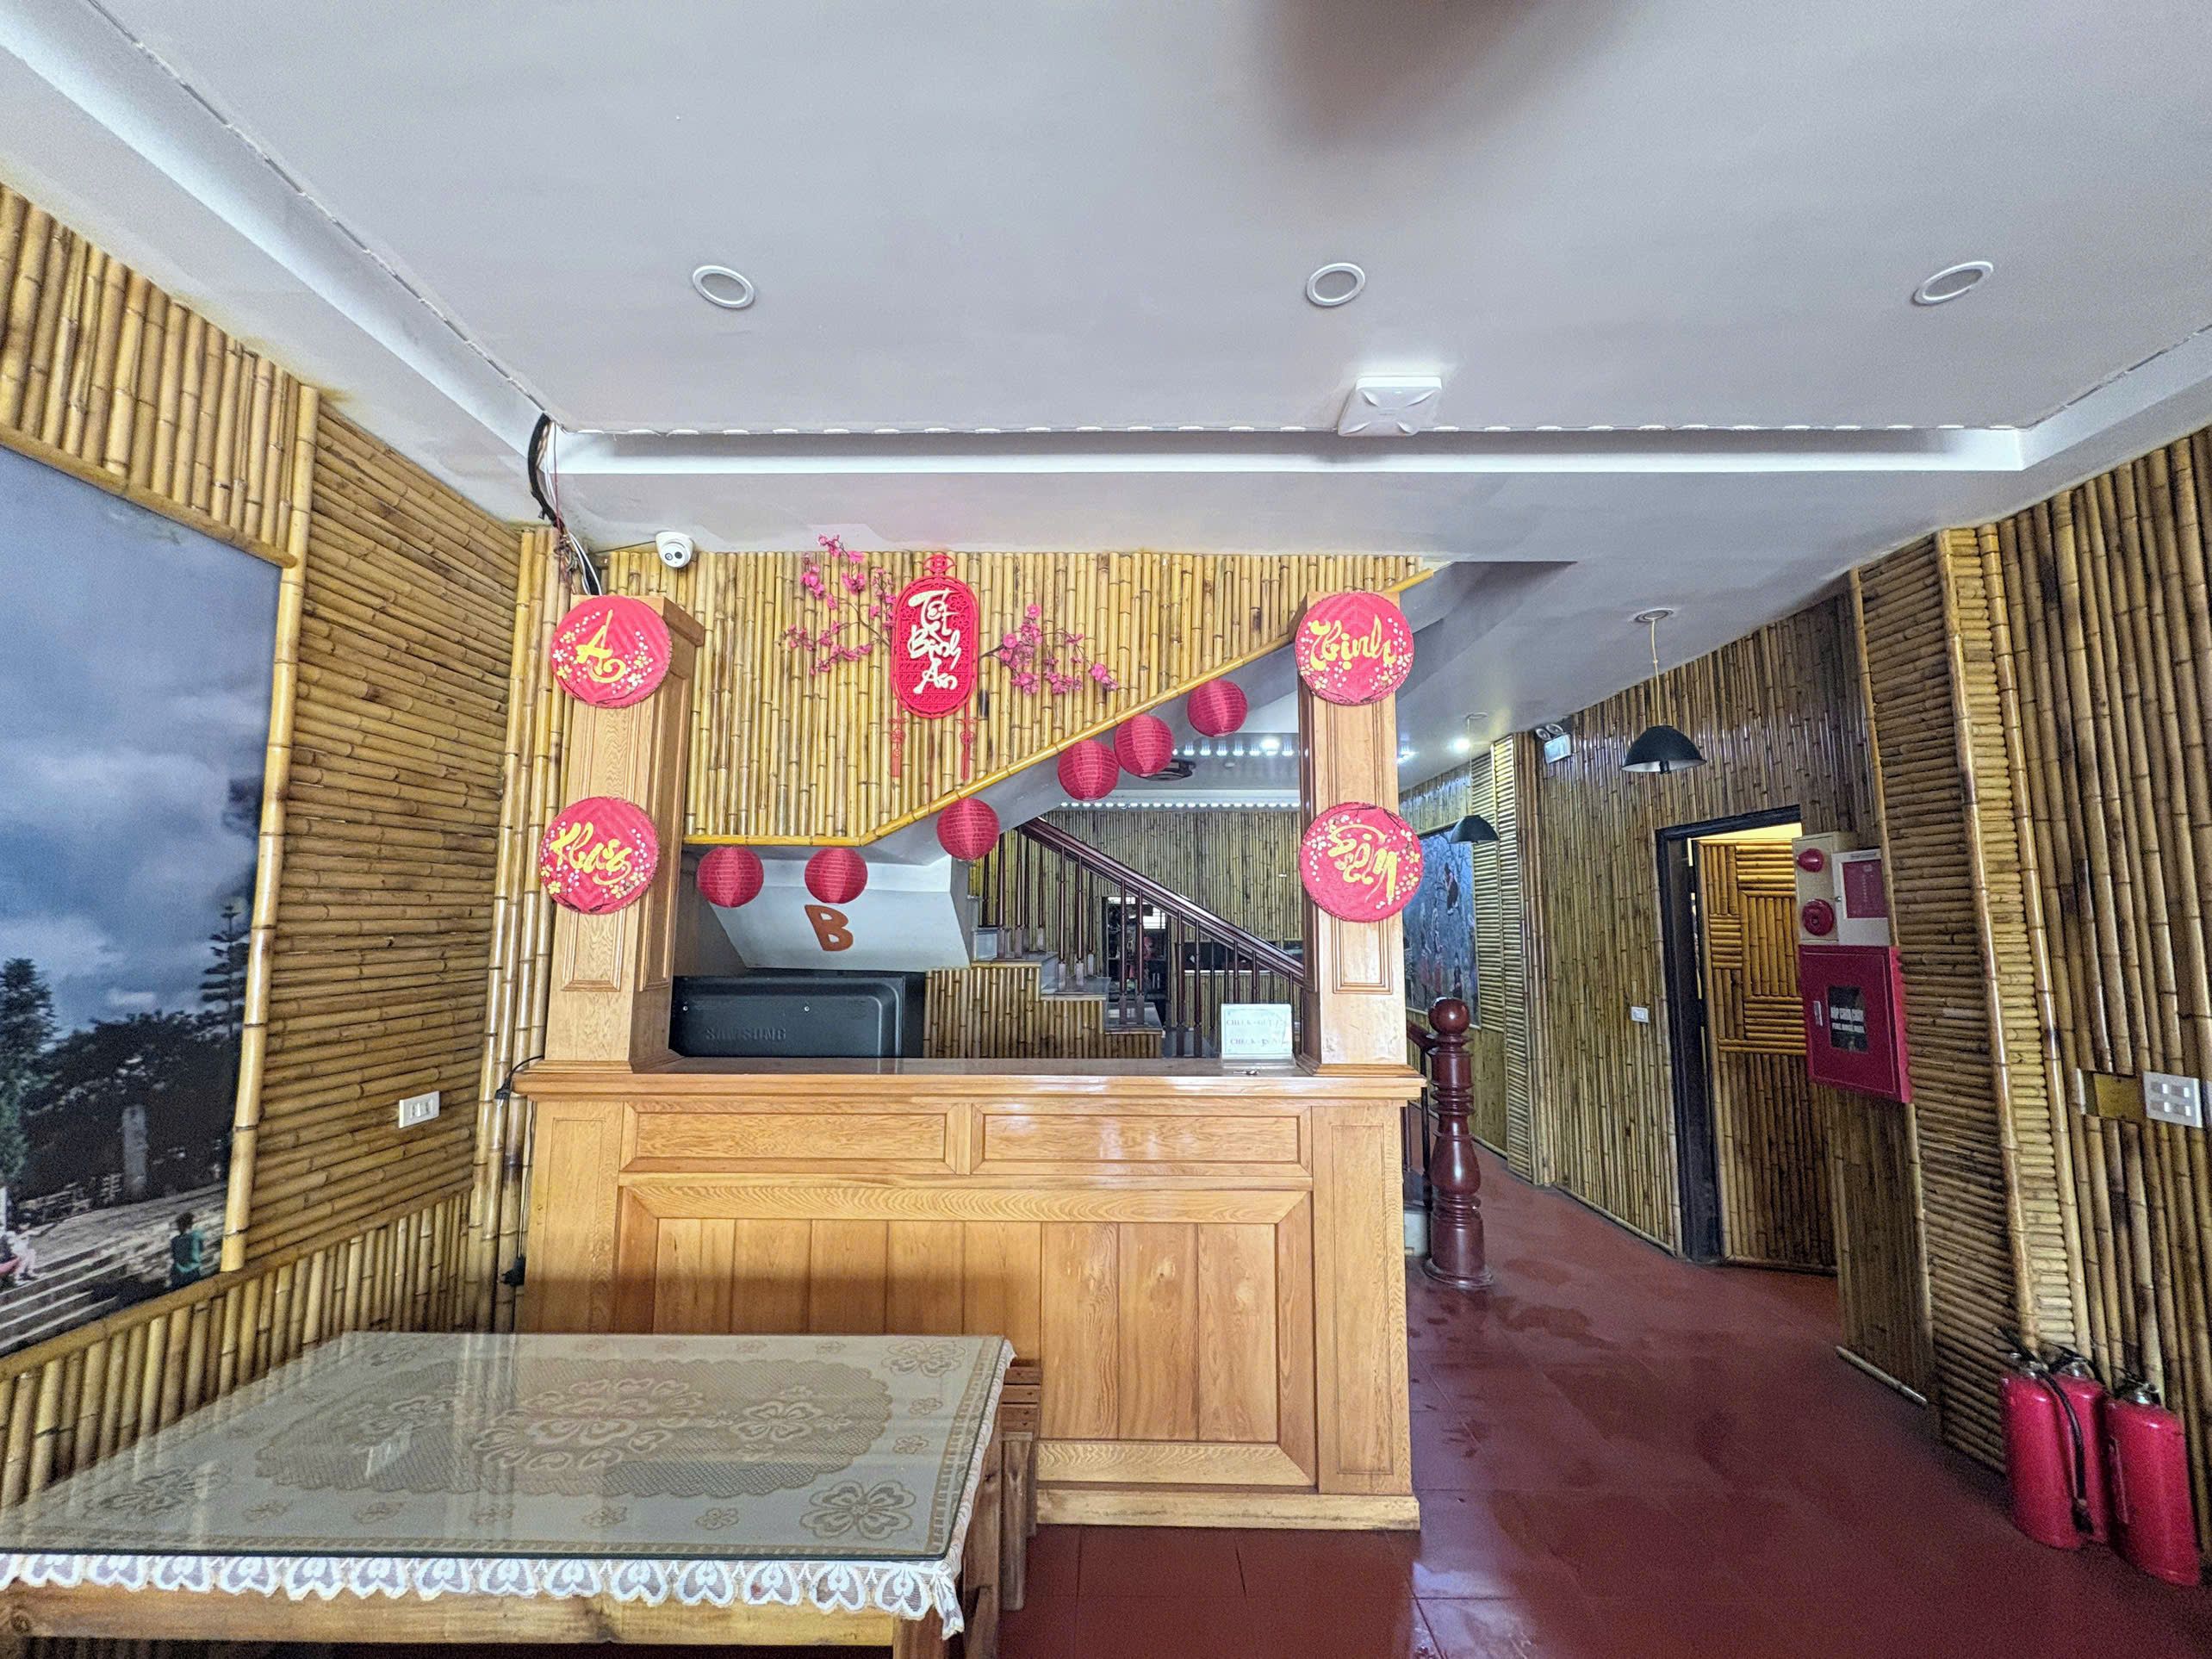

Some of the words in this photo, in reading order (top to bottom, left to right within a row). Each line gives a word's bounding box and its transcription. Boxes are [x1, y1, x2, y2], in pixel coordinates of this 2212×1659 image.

[1310, 614, 1396, 670] Thịnh
[913, 657, 958, 694] An
[805, 904, 854, 951] B
